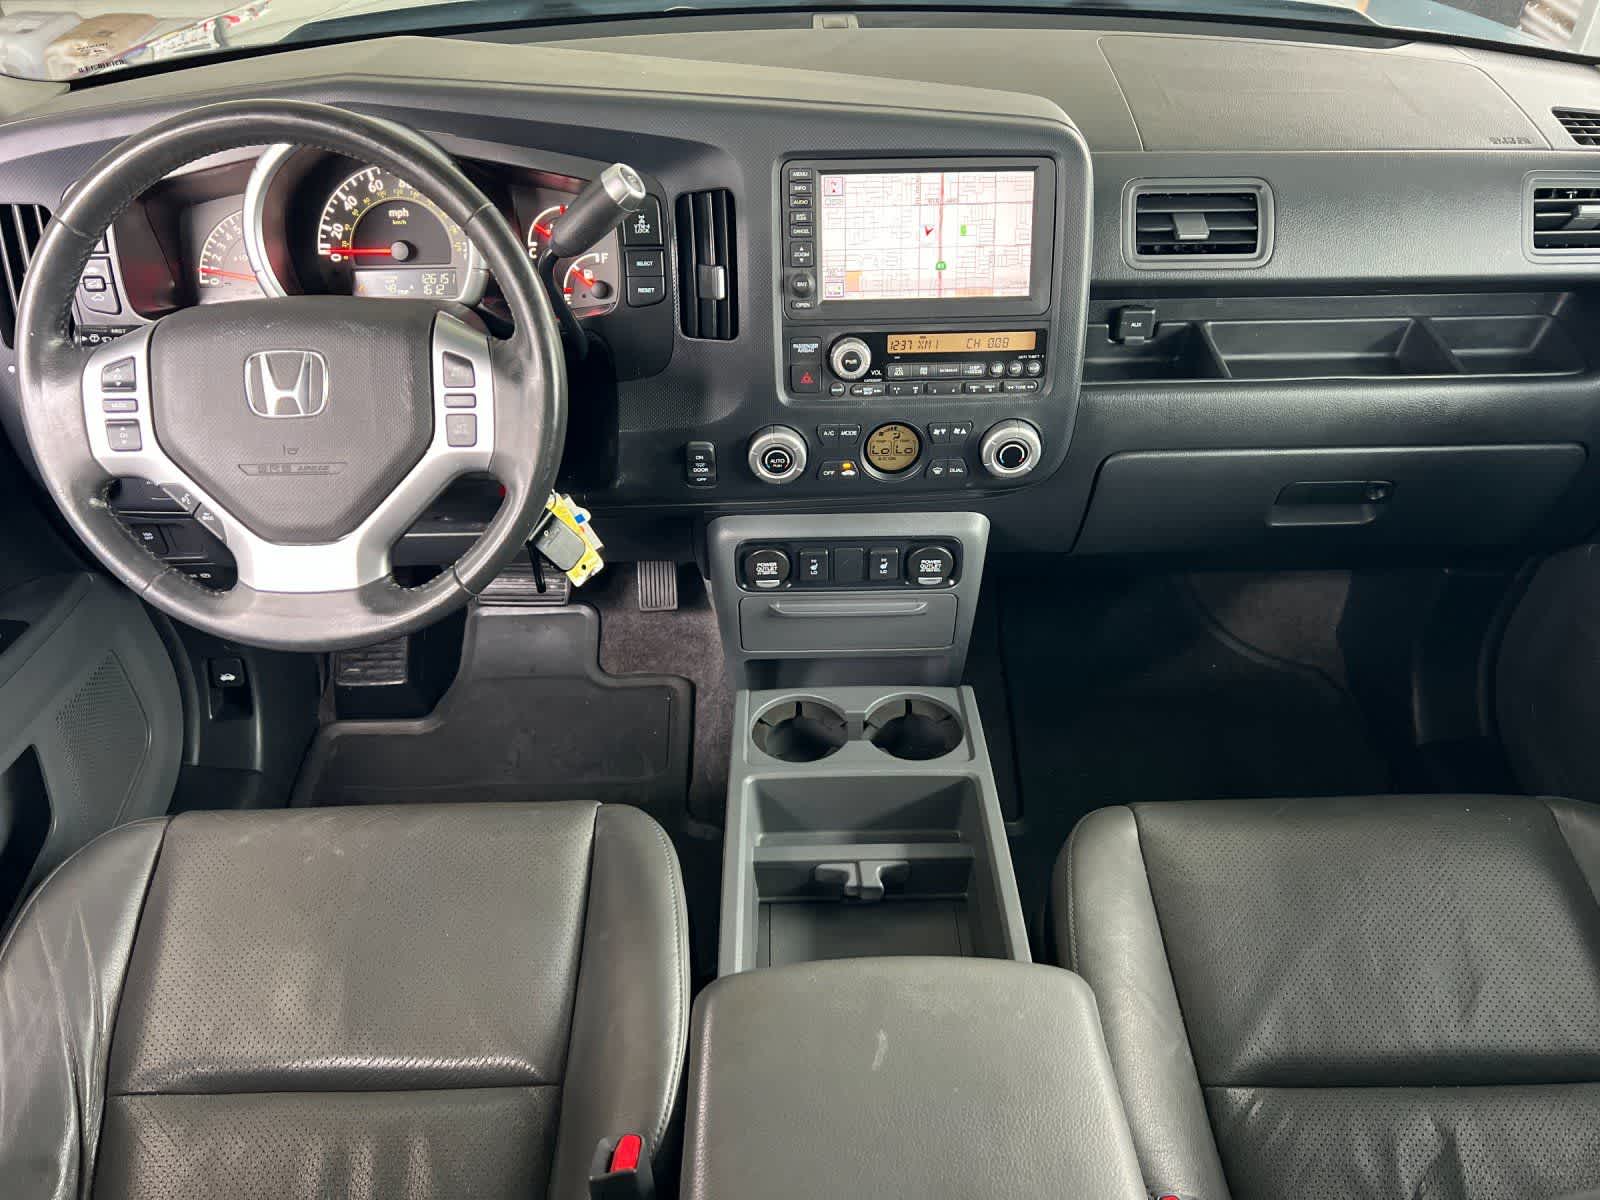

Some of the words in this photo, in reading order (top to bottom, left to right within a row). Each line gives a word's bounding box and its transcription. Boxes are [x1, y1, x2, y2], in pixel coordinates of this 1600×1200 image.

[368, 179, 384, 193] 60
[344, 195, 358, 212] 40
[388, 208, 410, 220] mph
[330, 223, 344, 240] 20
[330, 253, 342, 262] 0
[601, 253, 609, 264] F
